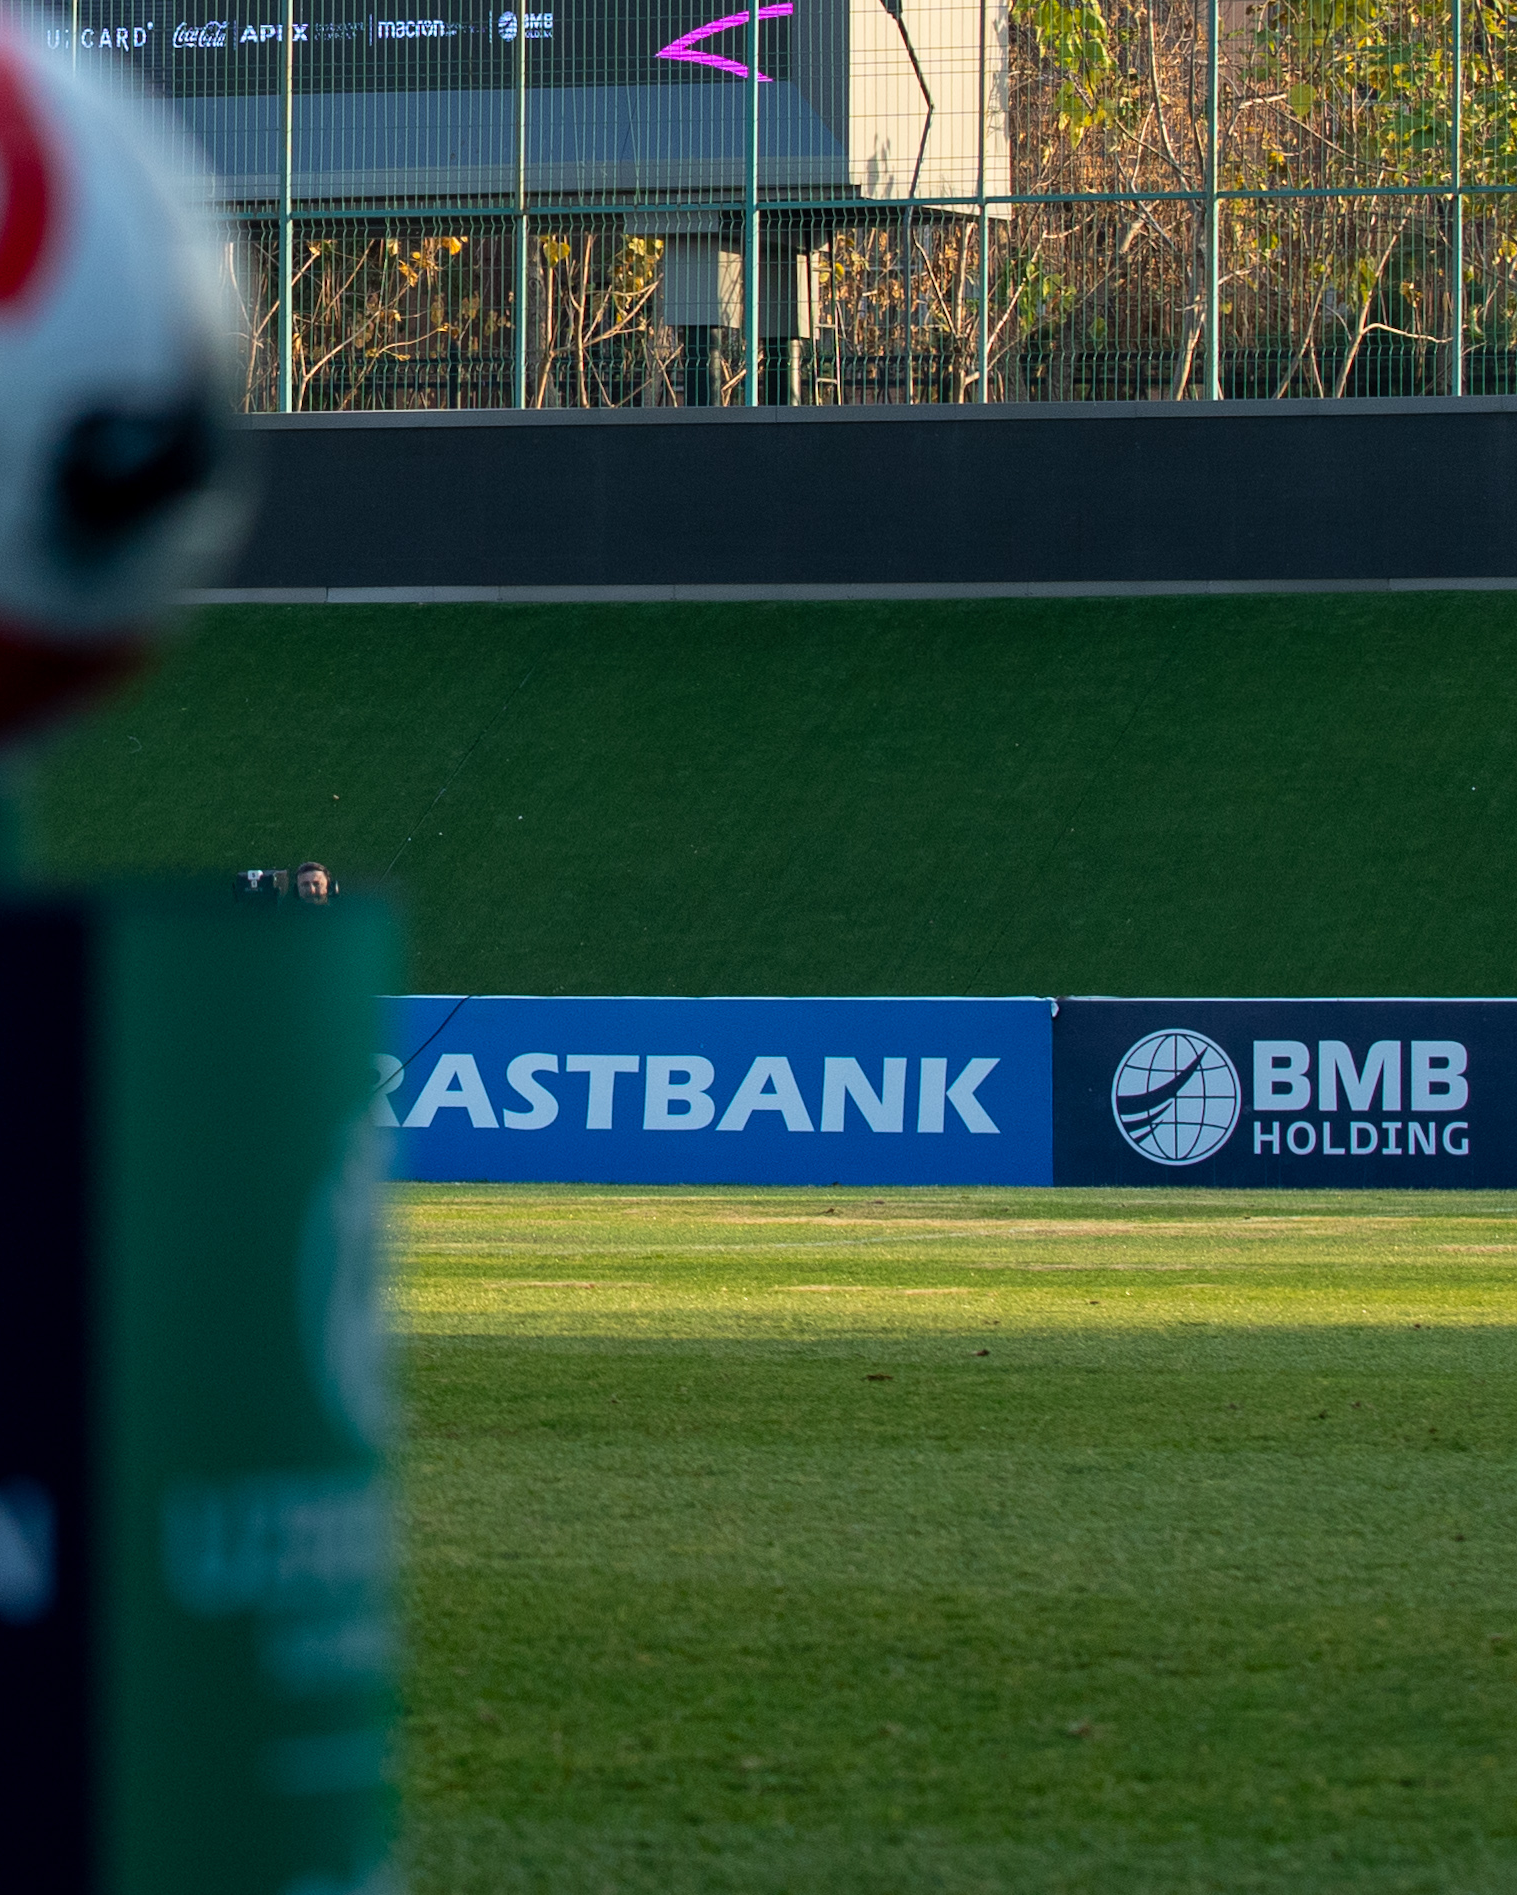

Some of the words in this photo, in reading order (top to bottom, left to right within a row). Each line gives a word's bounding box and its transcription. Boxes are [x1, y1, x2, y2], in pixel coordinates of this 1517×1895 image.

[377, 19, 446, 40] macron
[1252, 1040, 1470, 1112] BMB
[1253, 1120, 1471, 1156] HOLDING
